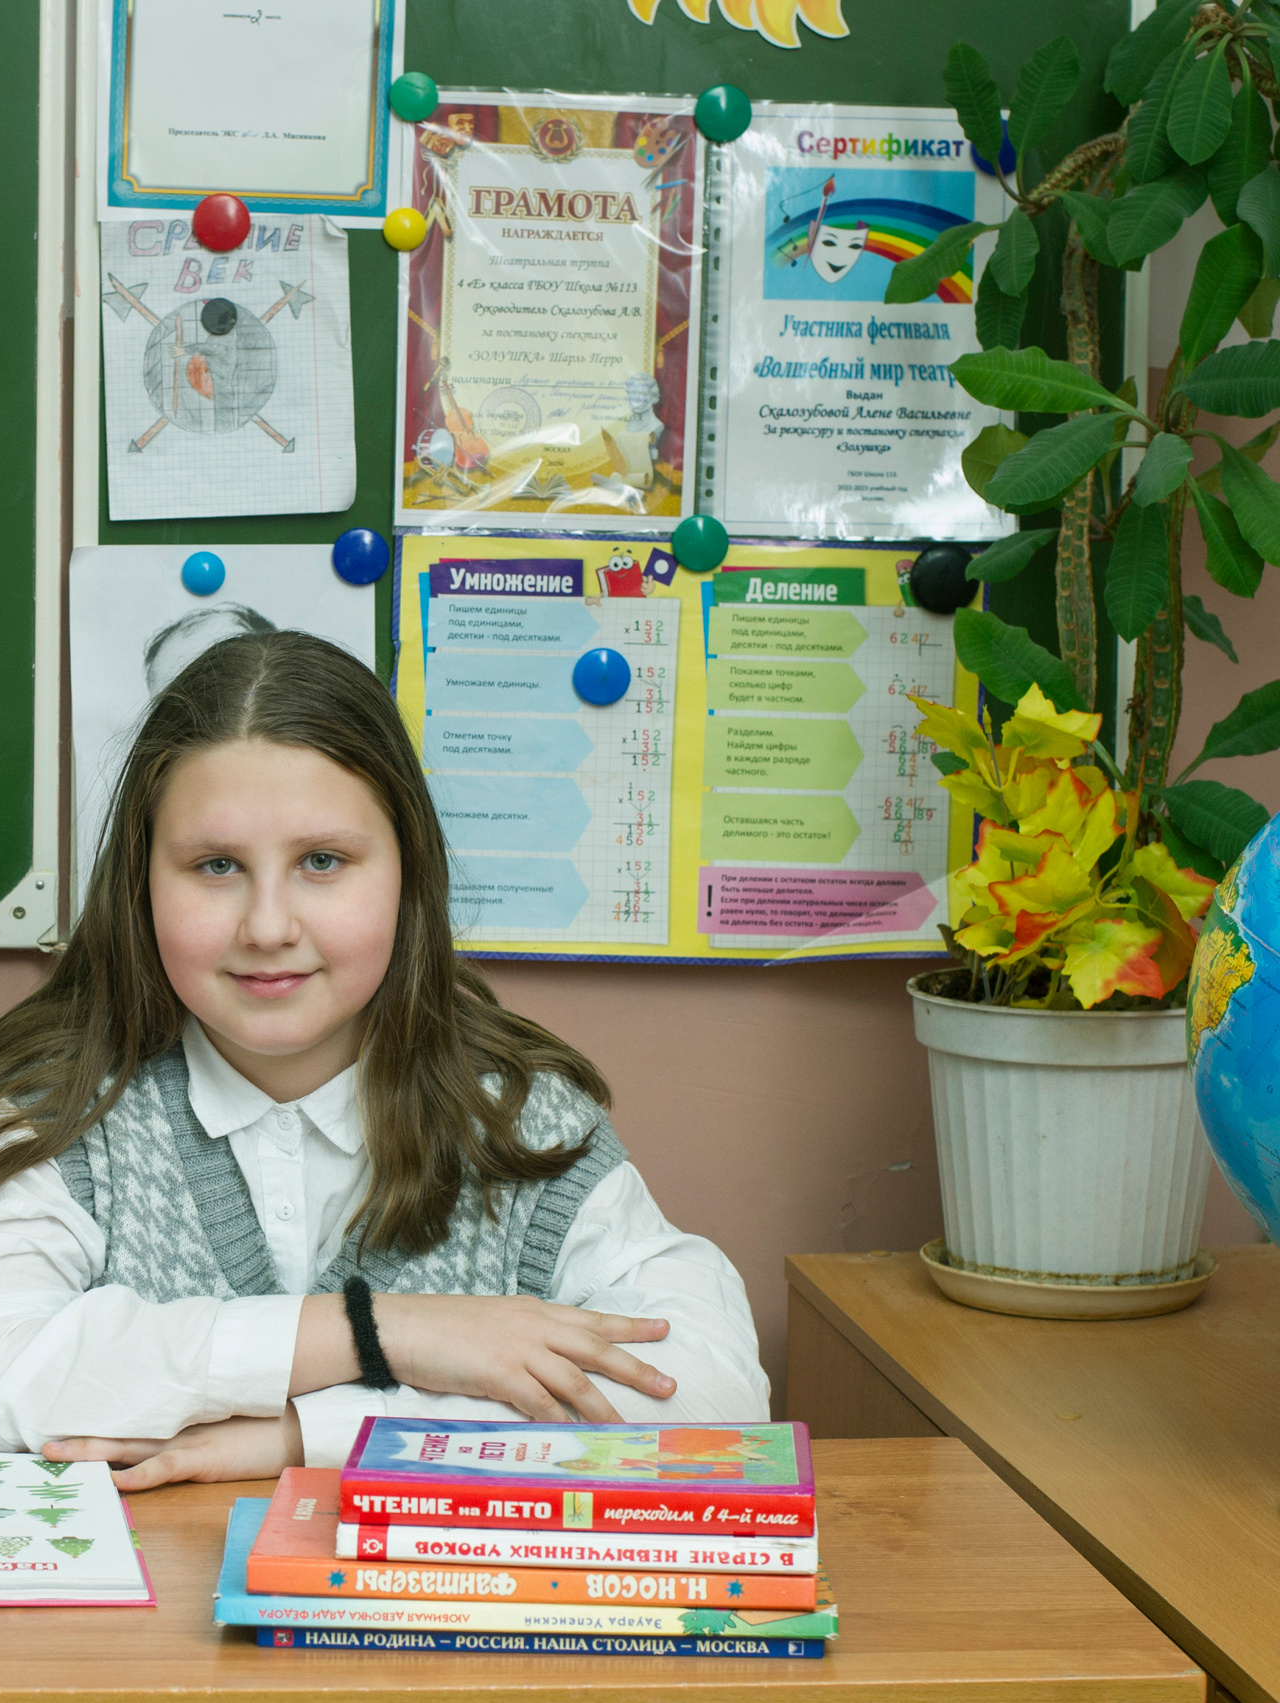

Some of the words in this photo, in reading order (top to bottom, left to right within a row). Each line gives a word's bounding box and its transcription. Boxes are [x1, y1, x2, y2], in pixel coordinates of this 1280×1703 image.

[169, 127, 219, 138] Председатель
[797, 130, 965, 162] Сертификат
[470, 187, 641, 223] ГРАМОТА
[128, 219, 304, 257] СРНИЕ
[501, 228, 604, 242] НАГРАЖДАЕТСЯ
[489, 255, 567, 268] Театральная
[570, 258, 610, 271] труппа
[173, 256, 254, 294] ВЕК
[457, 279, 464, 290] 4
[489, 280, 525, 292] класса
[527, 279, 564, 294] ГБОУ
[564, 280, 603, 293] Школа
[605, 281, 638, 294] №113
[472, 303, 548, 319] Руководитель
[550, 304, 616, 321] Скалозубова
[617, 305, 642, 319] А.В.
[481, 328, 494, 338] за
[496, 328, 558, 343] постановку
[561, 330, 618, 344] спектакля
[779, 314, 863, 339] Участника
[867, 315, 952, 345] фестиваля
[467, 350, 546, 365] «ЗОЛУШКА»
[548, 351, 587, 367] Шарль
[587, 352, 623, 368] Перро
[753, 356, 865, 380] «Волшебный
[869, 362, 905, 387] мир
[451, 375, 513, 387] номинации
[845, 389, 884, 402] Выдан
[758, 404, 851, 423] Скалозубовой
[851, 407, 893, 421] Алене
[895, 407, 972, 421] Васильевне
[763, 424, 778, 436] За
[779, 426, 835, 439] режиссуру
[836, 427, 844, 436] и
[846, 427, 908, 440] постановку
[836, 441, 892, 454] «Золушка»
[449, 567, 574, 593] Умножение
[745, 577, 838, 602] Деление
[449, 604, 483, 614] Пишем
[484, 605, 528, 616] единицы
[448, 619, 466, 629] под
[467, 619, 524, 630] единицами,
[732, 613, 766, 624] Пишем
[767, 614, 810, 625] единицы
[447, 632, 485, 642] десятки
[492, 633, 511, 643] под
[511, 633, 563, 644] десятками.
[731, 628, 750, 638] под
[750, 628, 807, 639] единицами,
[730, 641, 768, 651] десятки
[775, 642, 794, 652] под
[794, 643, 846, 653] десятками.
[729, 667, 773, 677] Покажем
[775, 668, 816, 679] точками,
[445, 677, 495, 689] Умножаем
[496, 678, 542, 690] единицы.
[729, 681, 767, 691] сколько
[767, 681, 793, 692] цифр
[728, 692, 756, 703] будет
[764, 694, 806, 705] частном.
[442, 731, 486, 742] Отметим
[487, 733, 513, 744] точку
[726, 727, 776, 738] Разделим.
[442, 745, 461, 755] под
[461, 745, 514, 756] десятками.
[726, 741, 763, 752] Найдем
[765, 742, 798, 753] цифры
[733, 755, 771, 765] каждом
[772, 756, 811, 767] разряде
[725, 767, 769, 777] частного.
[439, 810, 489, 820] Умножаем
[491, 812, 530, 821] десятки.
[723, 815, 779, 826] Оставшаяся
[780, 816, 805, 827] часть
[722, 829, 768, 839] делимого
[776, 830, 791, 840] это
[792, 830, 832, 841] остаток!
[721, 874, 738, 884] При
[739, 875, 773, 884] делении
[780, 876, 816, 885] остатком
[450, 883, 496, 893] адываем
[497, 884, 554, 894] полученные
[721, 885, 741, 893] быть
[742, 887, 775, 895] меньше
[721, 896, 739, 905] Если
[740, 897, 756, 906] при
[417, 1433, 451, 1461] ЧТЕНИЕ
[478, 1441, 507, 1461] ЛЕТО
[353, 1494, 452, 1516] ЧТЕНИЕ
[458, 1504, 481, 1516] на
[485, 1499, 552, 1519] ЛЕТО
[603, 1503, 695, 1526] переходим
[702, 1505, 713, 1523] в
[717, 1506, 754, 1525] 4-й
[756, 1511, 800, 1525] класс
[510, 1545, 678, 1564] НЕВЫУЧЕННЫХ
[779, 1551, 795, 1567] В
[258, 1607, 310, 1621] ФЁДОРА
[312, 1608, 346, 1620] ДЯДИ
[348, 1609, 405, 1622] ДЕВОЧКА
[407, 1610, 470, 1623] ЛЮБИМАЯ
[524, 1614, 603, 1629] Успенский
[608, 1615, 663, 1630] Эдуард
[305, 1630, 361, 1646] НАША
[363, 1631, 436, 1650] РОДИНА
[455, 1636, 529, 1650] РОССИЯ.
[533, 1636, 586, 1651] НАША
[591, 1637, 677, 1655] СТОЛИЦА
[696, 1639, 770, 1653] МОСКВА
